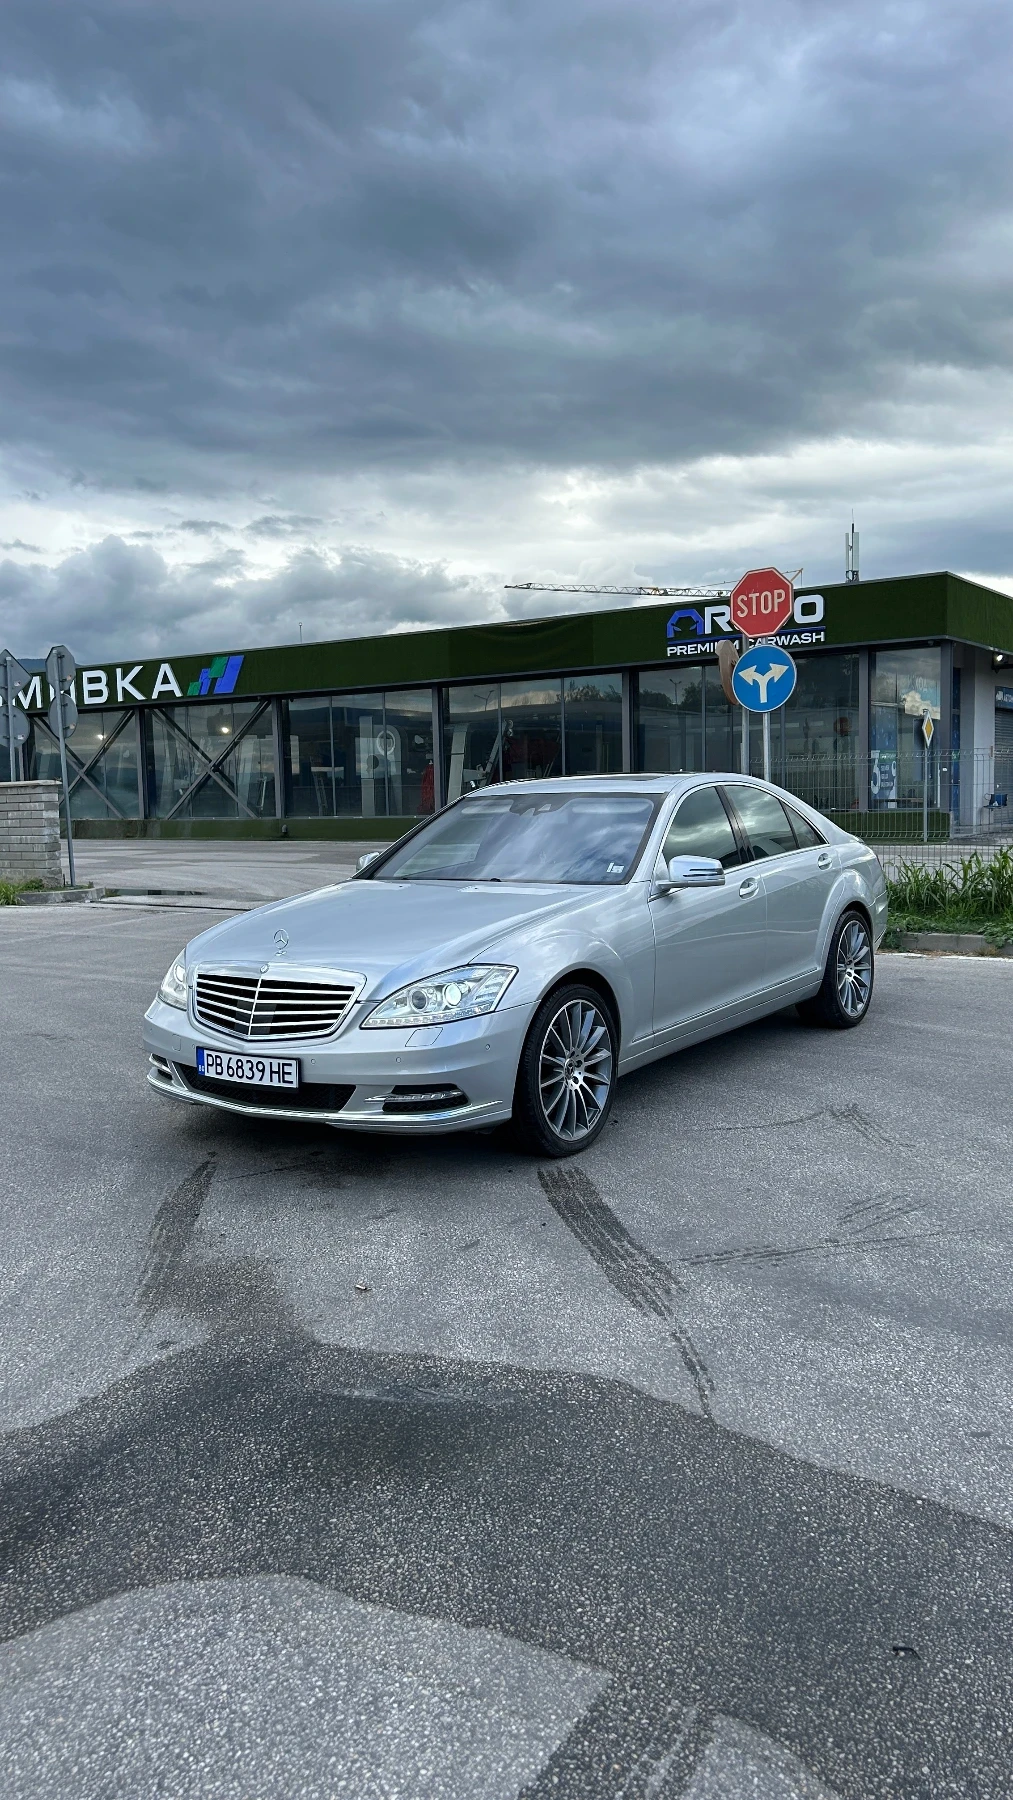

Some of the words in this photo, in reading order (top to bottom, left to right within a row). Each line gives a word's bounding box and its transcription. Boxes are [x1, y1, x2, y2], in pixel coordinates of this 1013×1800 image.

[667, 594, 825, 638] ARO
[737, 589, 786, 618] STOP
[667, 639, 740, 657] PREMI
[206, 1053, 224, 1076] PB
[226, 1057, 266, 1082] 6839
[269, 1061, 294, 1084] HE
